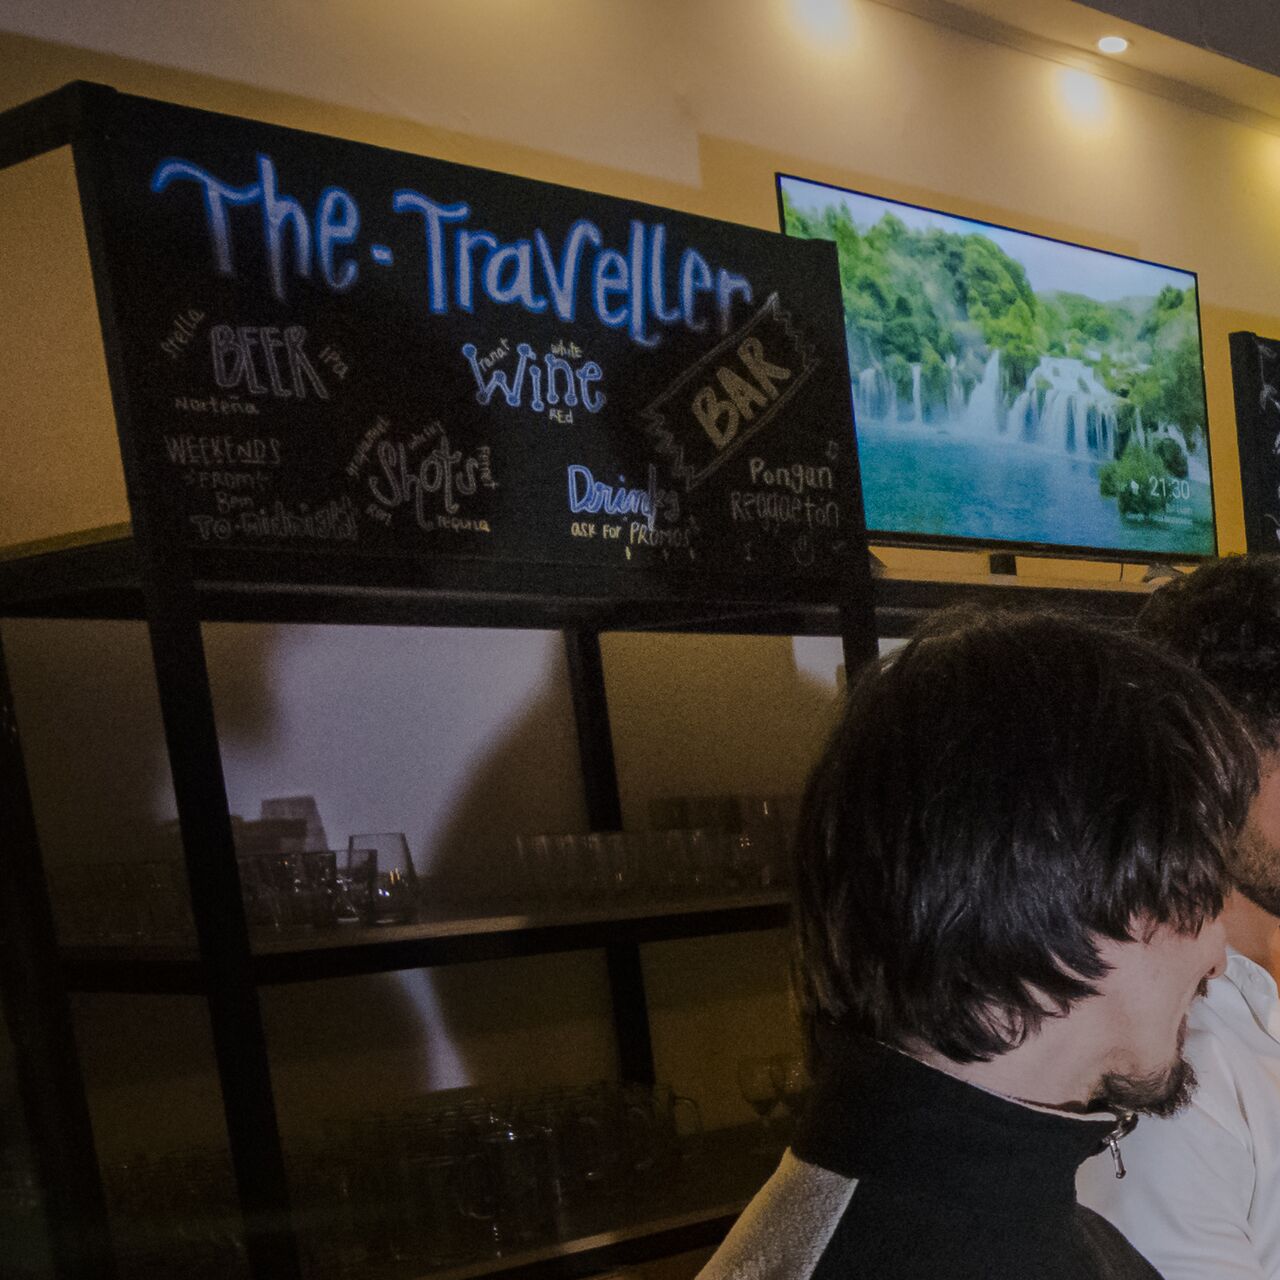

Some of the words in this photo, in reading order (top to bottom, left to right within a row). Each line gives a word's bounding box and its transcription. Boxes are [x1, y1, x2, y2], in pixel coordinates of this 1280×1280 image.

[208, 323, 330, 400] BEER
[462, 341, 607, 414] Wine
[691, 336, 792, 450] BAR
[163, 433, 282, 464] WEEKENDS
[368, 435, 479, 533] Shots
[1149, 475, 1190, 500] 21:30
